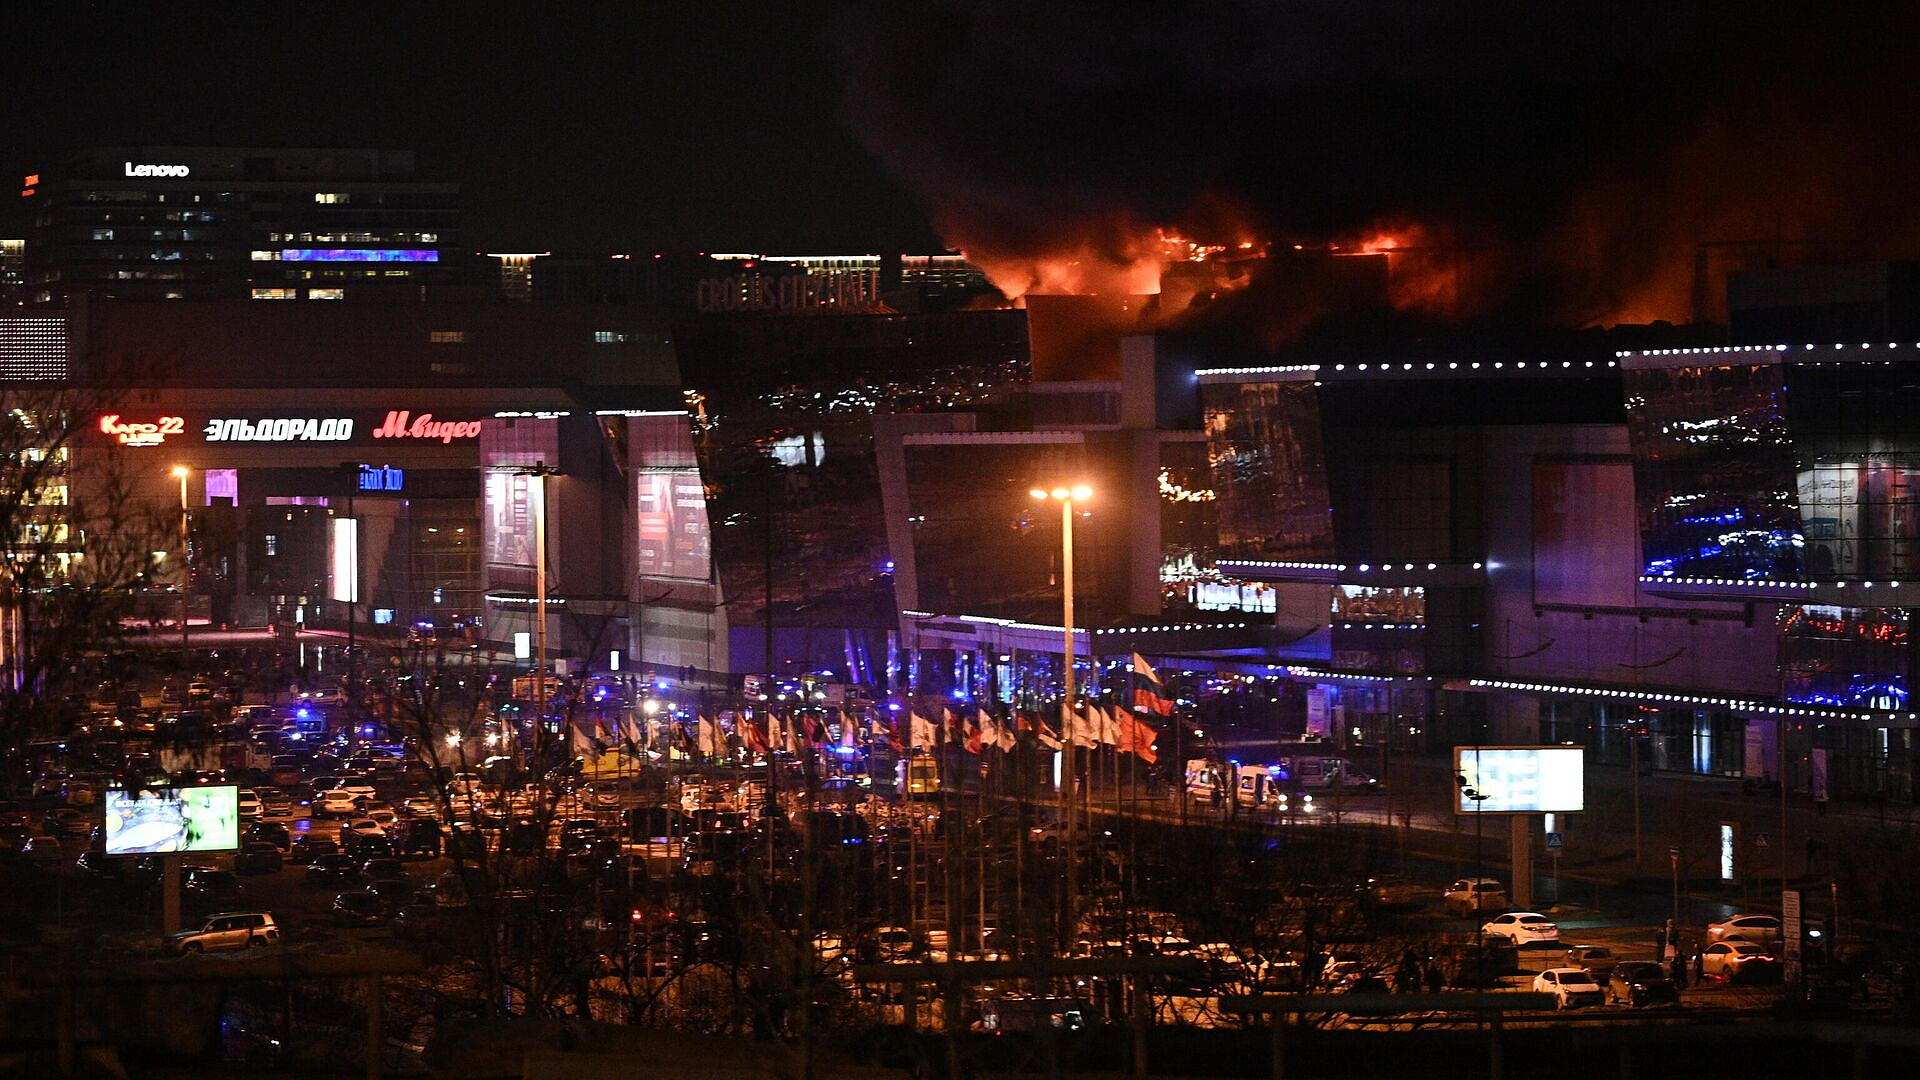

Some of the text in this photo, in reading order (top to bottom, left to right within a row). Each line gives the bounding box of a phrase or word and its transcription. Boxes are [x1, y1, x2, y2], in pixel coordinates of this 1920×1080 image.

[125, 161, 190, 177] Lenovo
[159, 416, 185, 434] 22
[203, 418, 353, 441] ЭЛЬДОРАДО
[372, 410, 482, 444] М.видео
